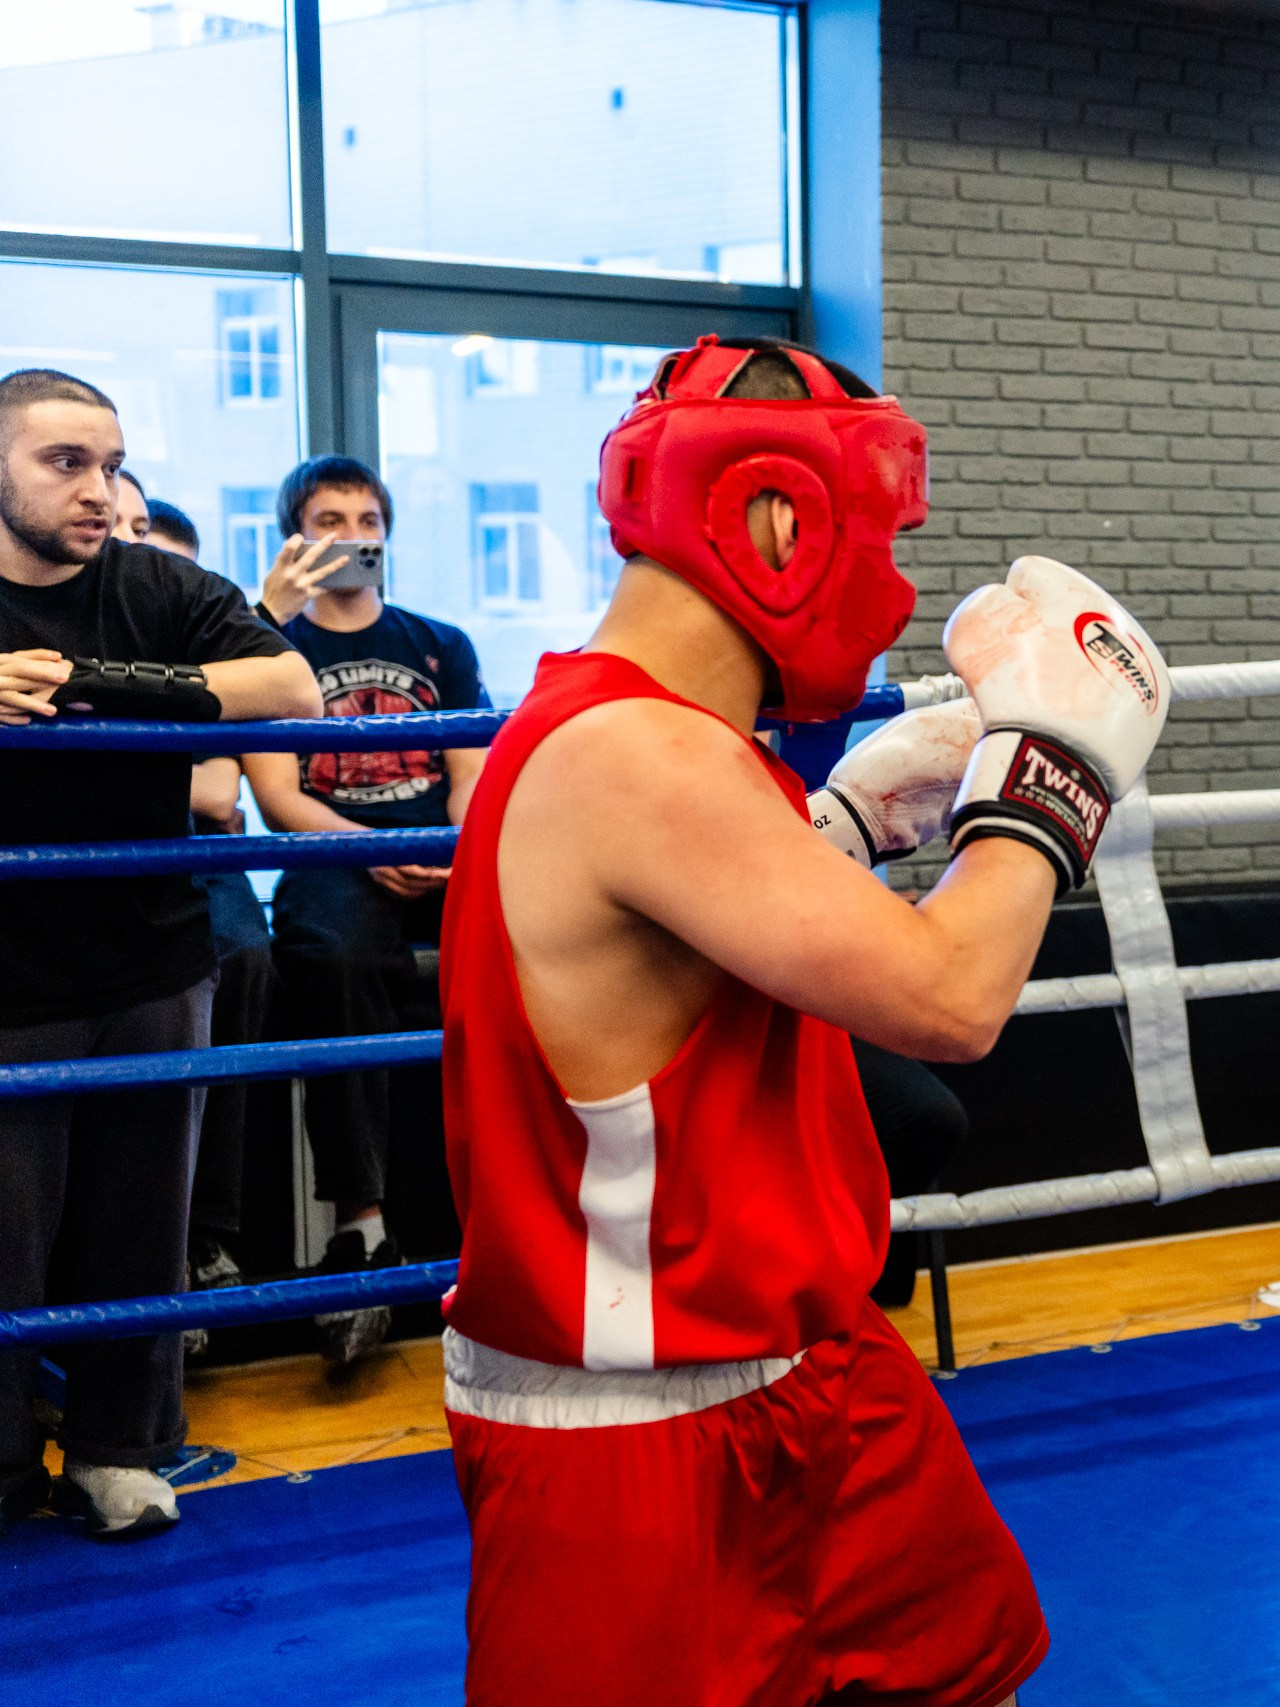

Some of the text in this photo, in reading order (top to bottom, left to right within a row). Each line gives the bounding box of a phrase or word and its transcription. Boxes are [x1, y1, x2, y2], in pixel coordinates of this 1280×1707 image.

[338, 664, 414, 690] LIMITS
[1085, 622, 1154, 702] TWINS
[1022, 746, 1103, 840] TWINS
